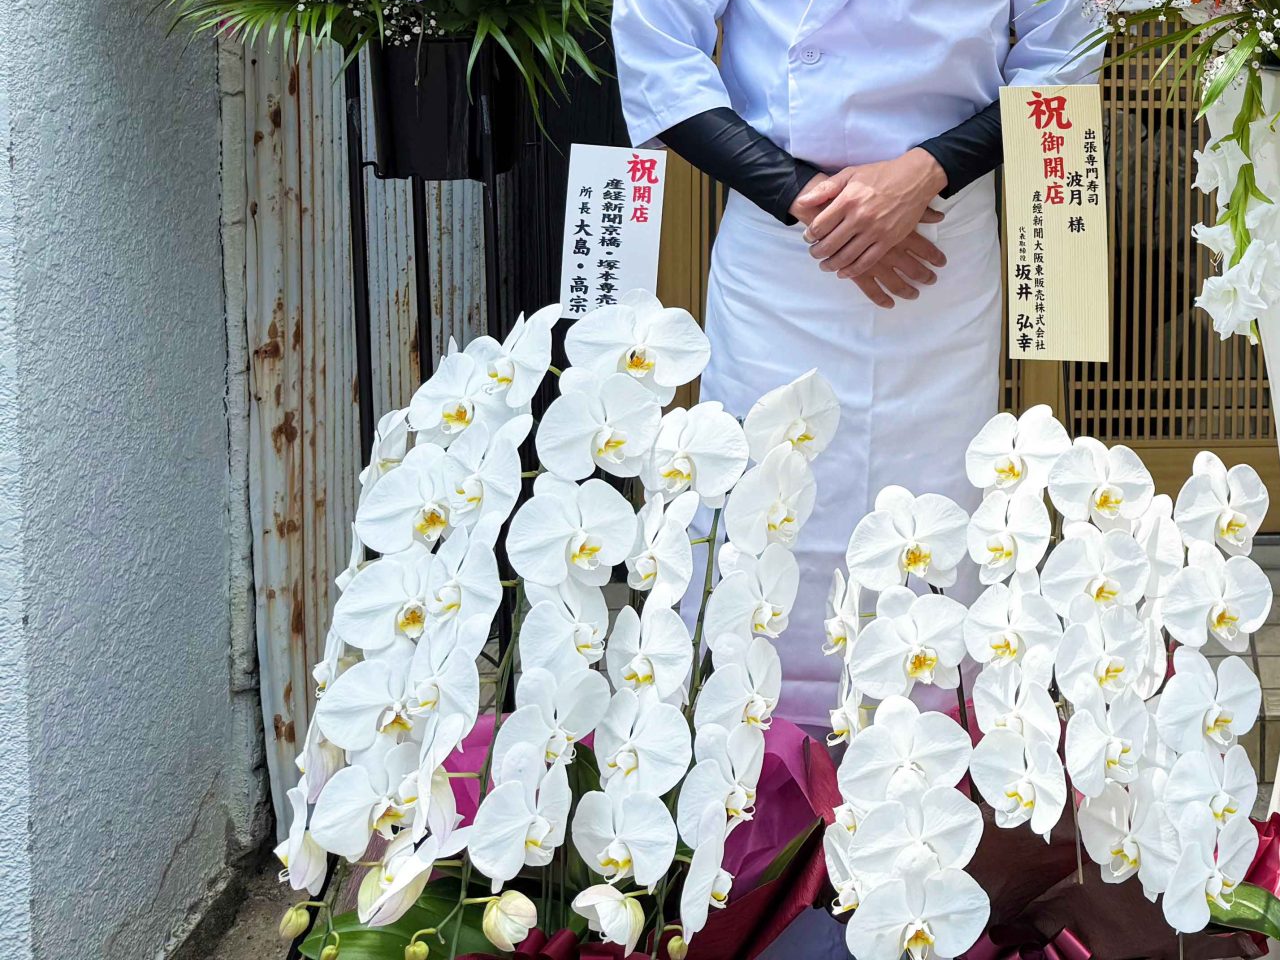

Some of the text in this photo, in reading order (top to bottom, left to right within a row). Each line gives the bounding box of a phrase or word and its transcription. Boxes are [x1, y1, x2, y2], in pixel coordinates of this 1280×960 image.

[1066, 171, 1086, 233] 波月 様
[1083, 129, 1099, 206] 出張専門寿司
